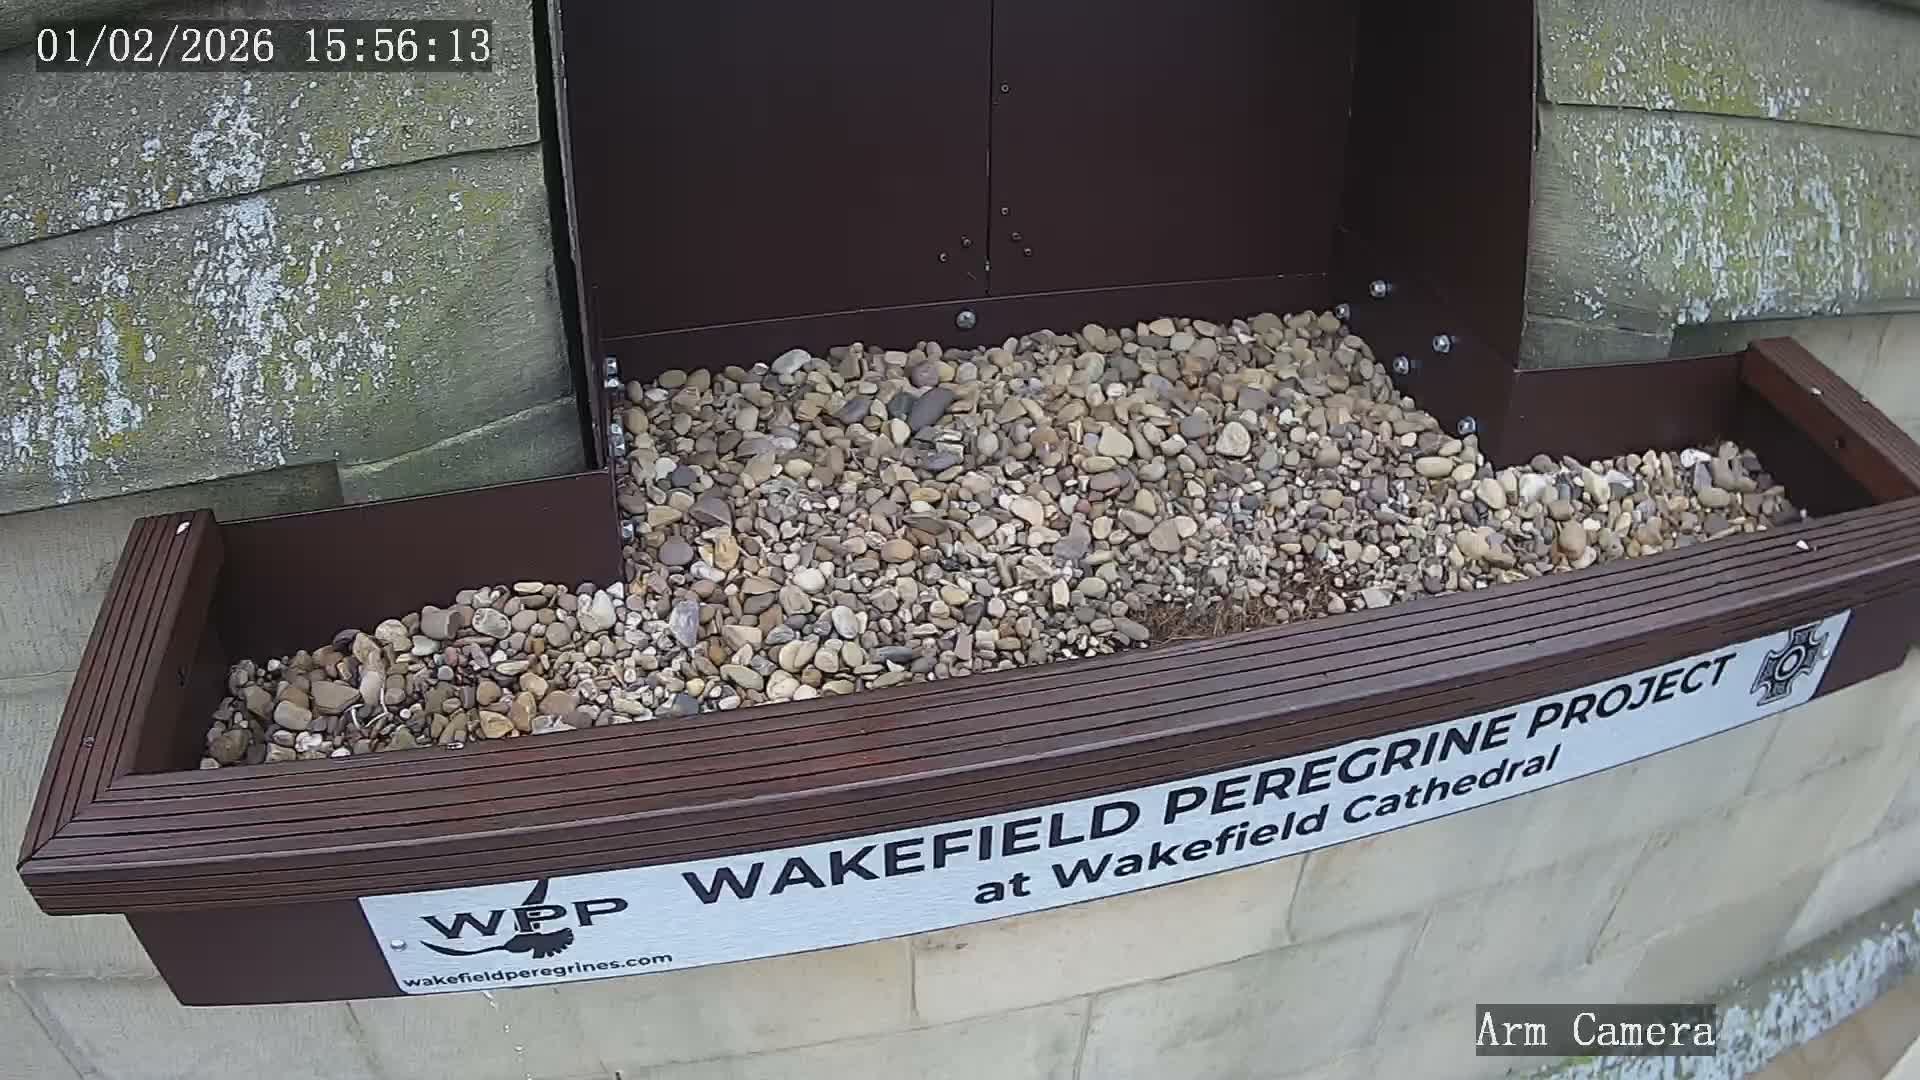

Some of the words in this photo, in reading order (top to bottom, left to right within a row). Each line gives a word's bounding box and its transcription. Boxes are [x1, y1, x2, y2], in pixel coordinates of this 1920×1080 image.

[682, 800, 1141, 905] WAKEFIELD
[1163, 712, 1518, 825] PEREGRINE
[1526, 652, 1738, 739] PROJECT
[975, 871, 1031, 905] at
[1051, 805, 1327, 889] Wakefield
[1342, 744, 1562, 824] Cathedral
[419, 897, 629, 940] WPP
[402, 952, 673, 988] wakefieldperegrines.com
